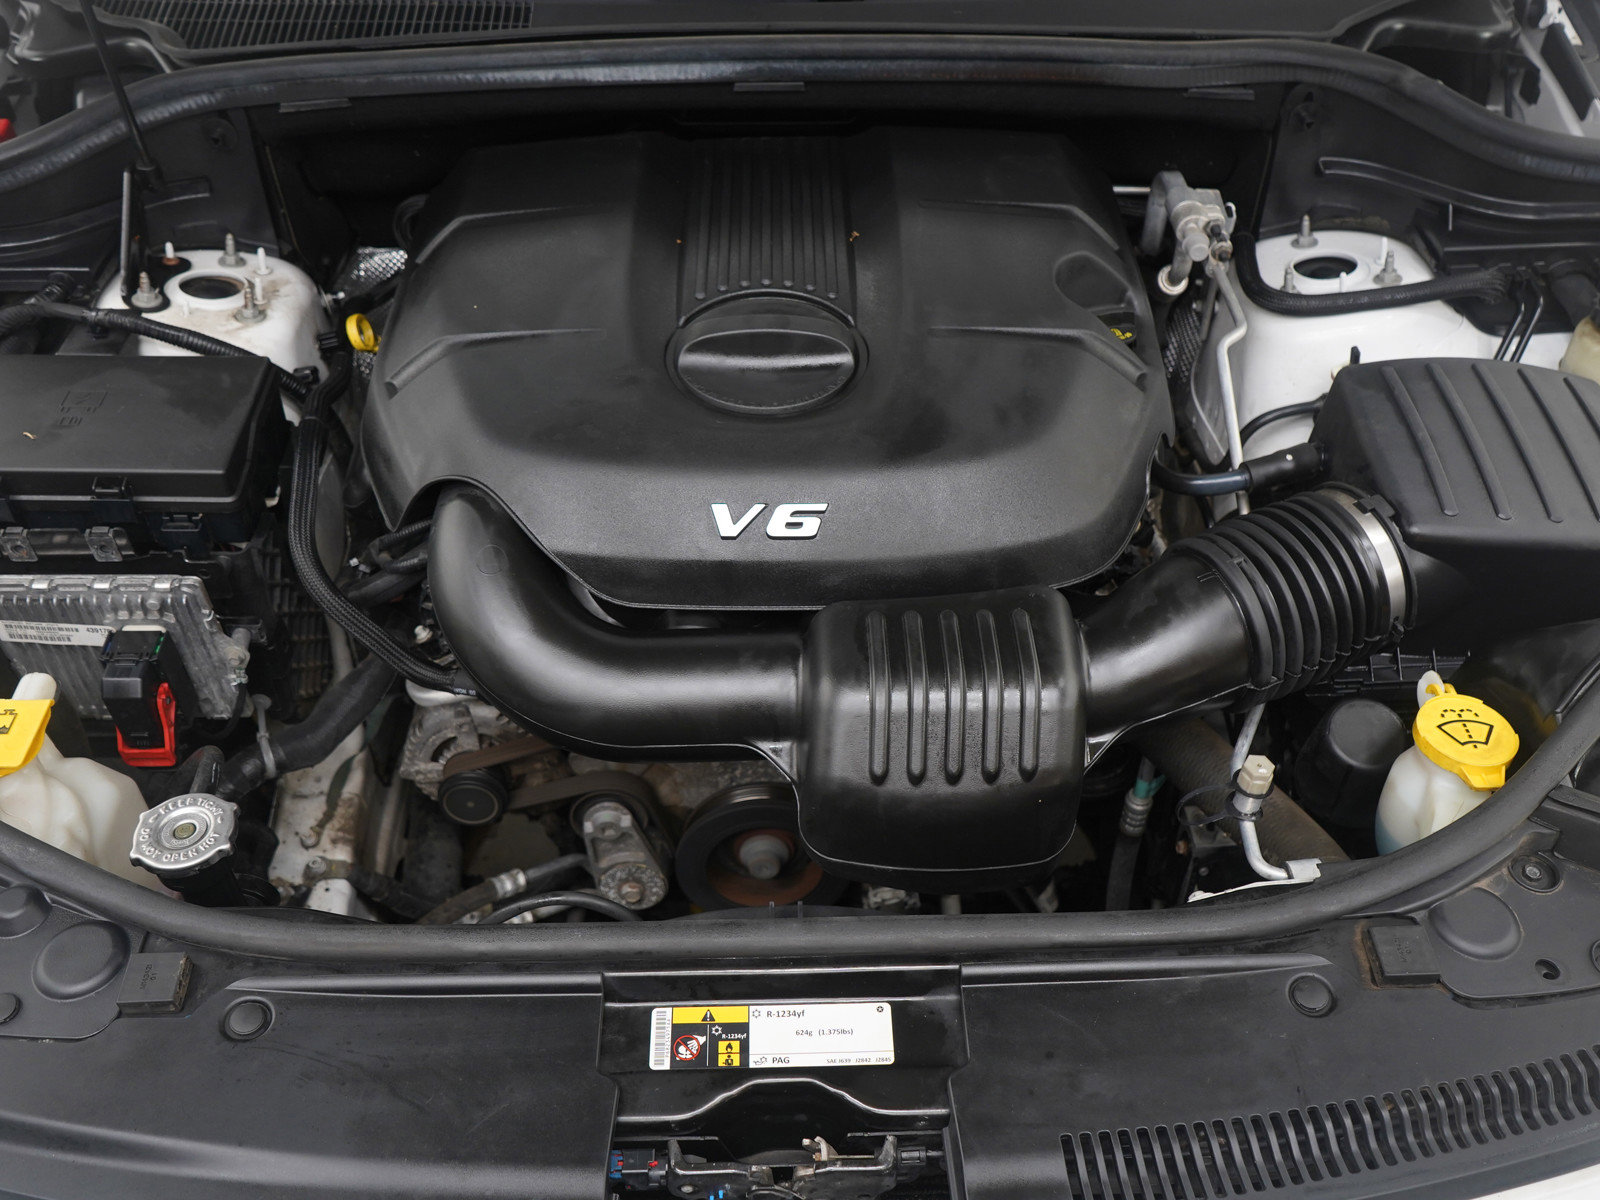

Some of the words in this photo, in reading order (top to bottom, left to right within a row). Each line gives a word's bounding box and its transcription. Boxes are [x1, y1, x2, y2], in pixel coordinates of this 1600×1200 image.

[710, 502, 829, 540] V6
[159, 797, 194, 815] KEEP
[197, 797, 224, 816] TIGHT
[162, 848, 199, 862] OPEN
[766, 1010, 805, 1018] R-1234yf
[795, 1029, 813, 1037] 624g
[818, 1028, 854, 1037] (1.375lbs)
[772, 1056, 790, 1064] PAG
